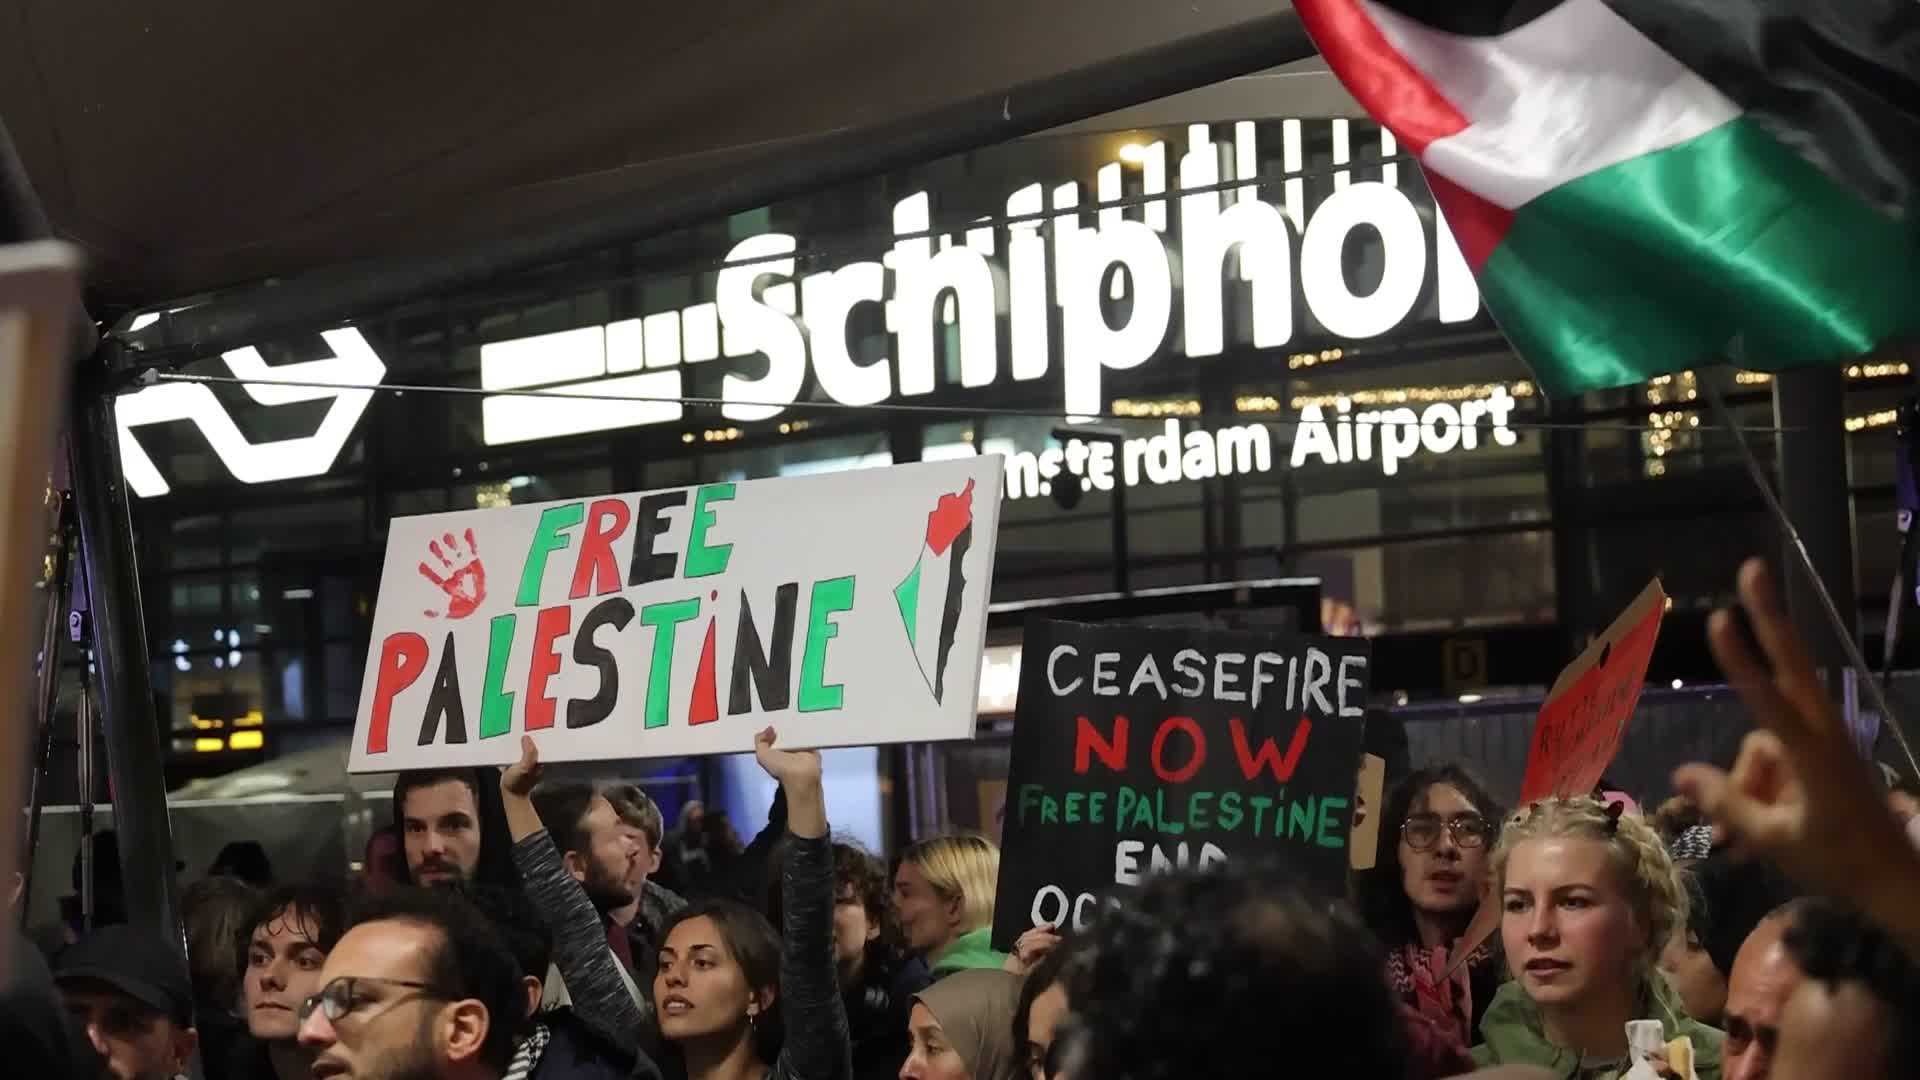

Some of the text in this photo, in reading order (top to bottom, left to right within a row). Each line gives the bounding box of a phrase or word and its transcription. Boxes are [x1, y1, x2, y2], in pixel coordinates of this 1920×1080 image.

[1000, 386, 1517, 500] msterdam Airport
[515, 483, 737, 607] FREE
[1046, 644, 1369, 718] CEASEFIRE
[1073, 715, 1312, 784] NOW
[1017, 783, 1108, 831] FREE
